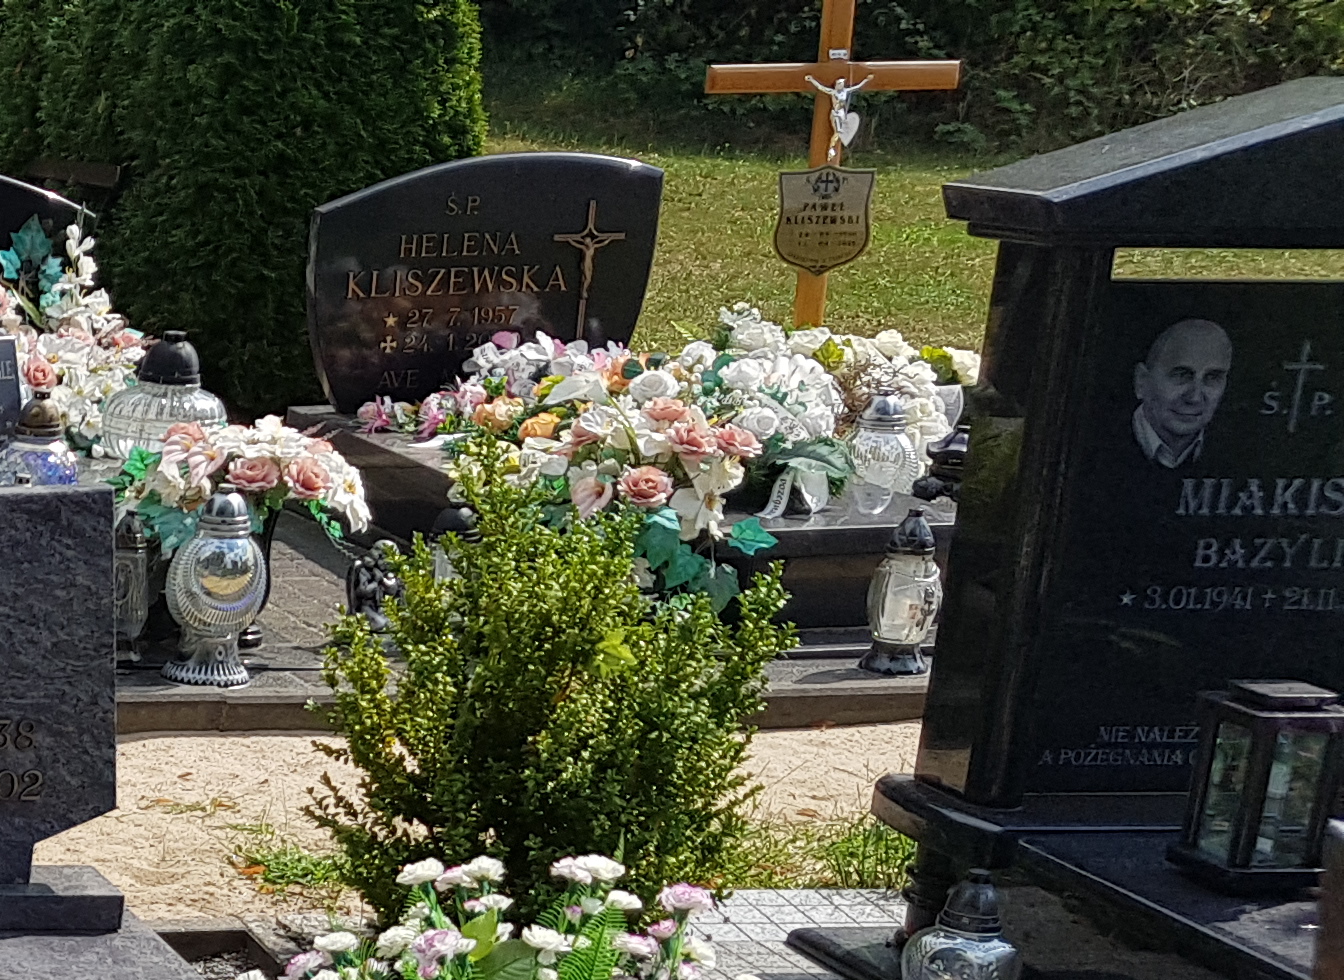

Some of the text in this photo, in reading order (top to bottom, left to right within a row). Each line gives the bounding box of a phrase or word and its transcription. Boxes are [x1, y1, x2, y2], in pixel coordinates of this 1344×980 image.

[399, 232, 521, 258] HELENA
[347, 264, 568, 300] KLISZEWSKA
[472, 306, 520, 325] 1957
[378, 369, 420, 390] AVE
[1097, 726, 1131, 744] NIE
